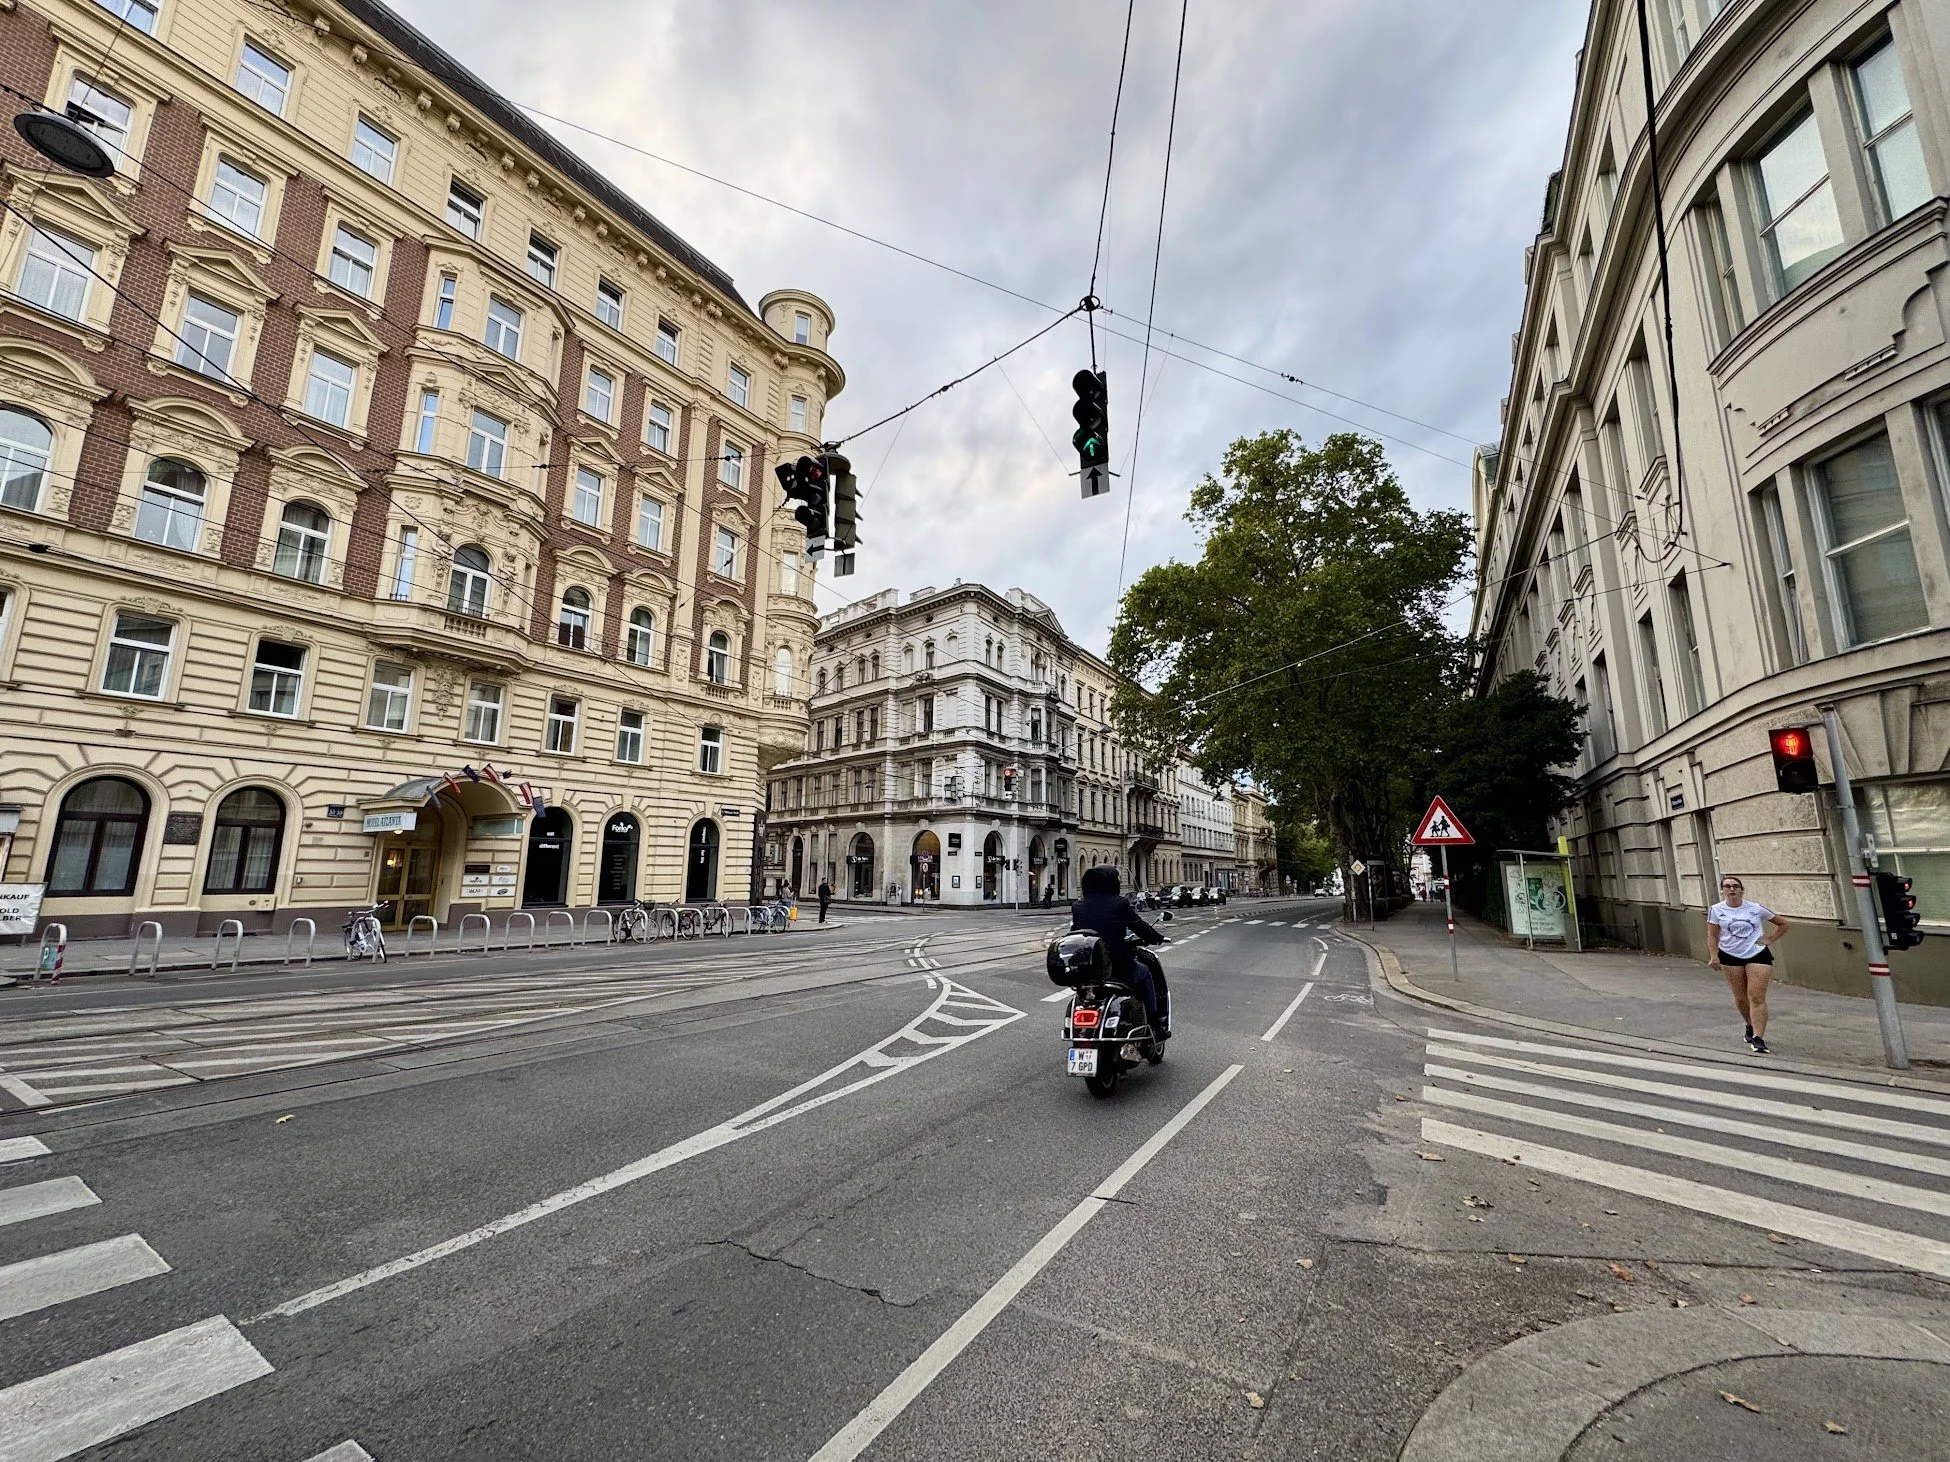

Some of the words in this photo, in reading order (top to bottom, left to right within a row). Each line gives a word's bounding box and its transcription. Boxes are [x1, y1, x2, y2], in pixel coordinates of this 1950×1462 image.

[381, 816, 402, 827] ATLANTA
[1078, 1051, 1084, 1060] W
[1072, 1062, 1076, 1071] 7
[1078, 1061, 1093, 1071] GPD
